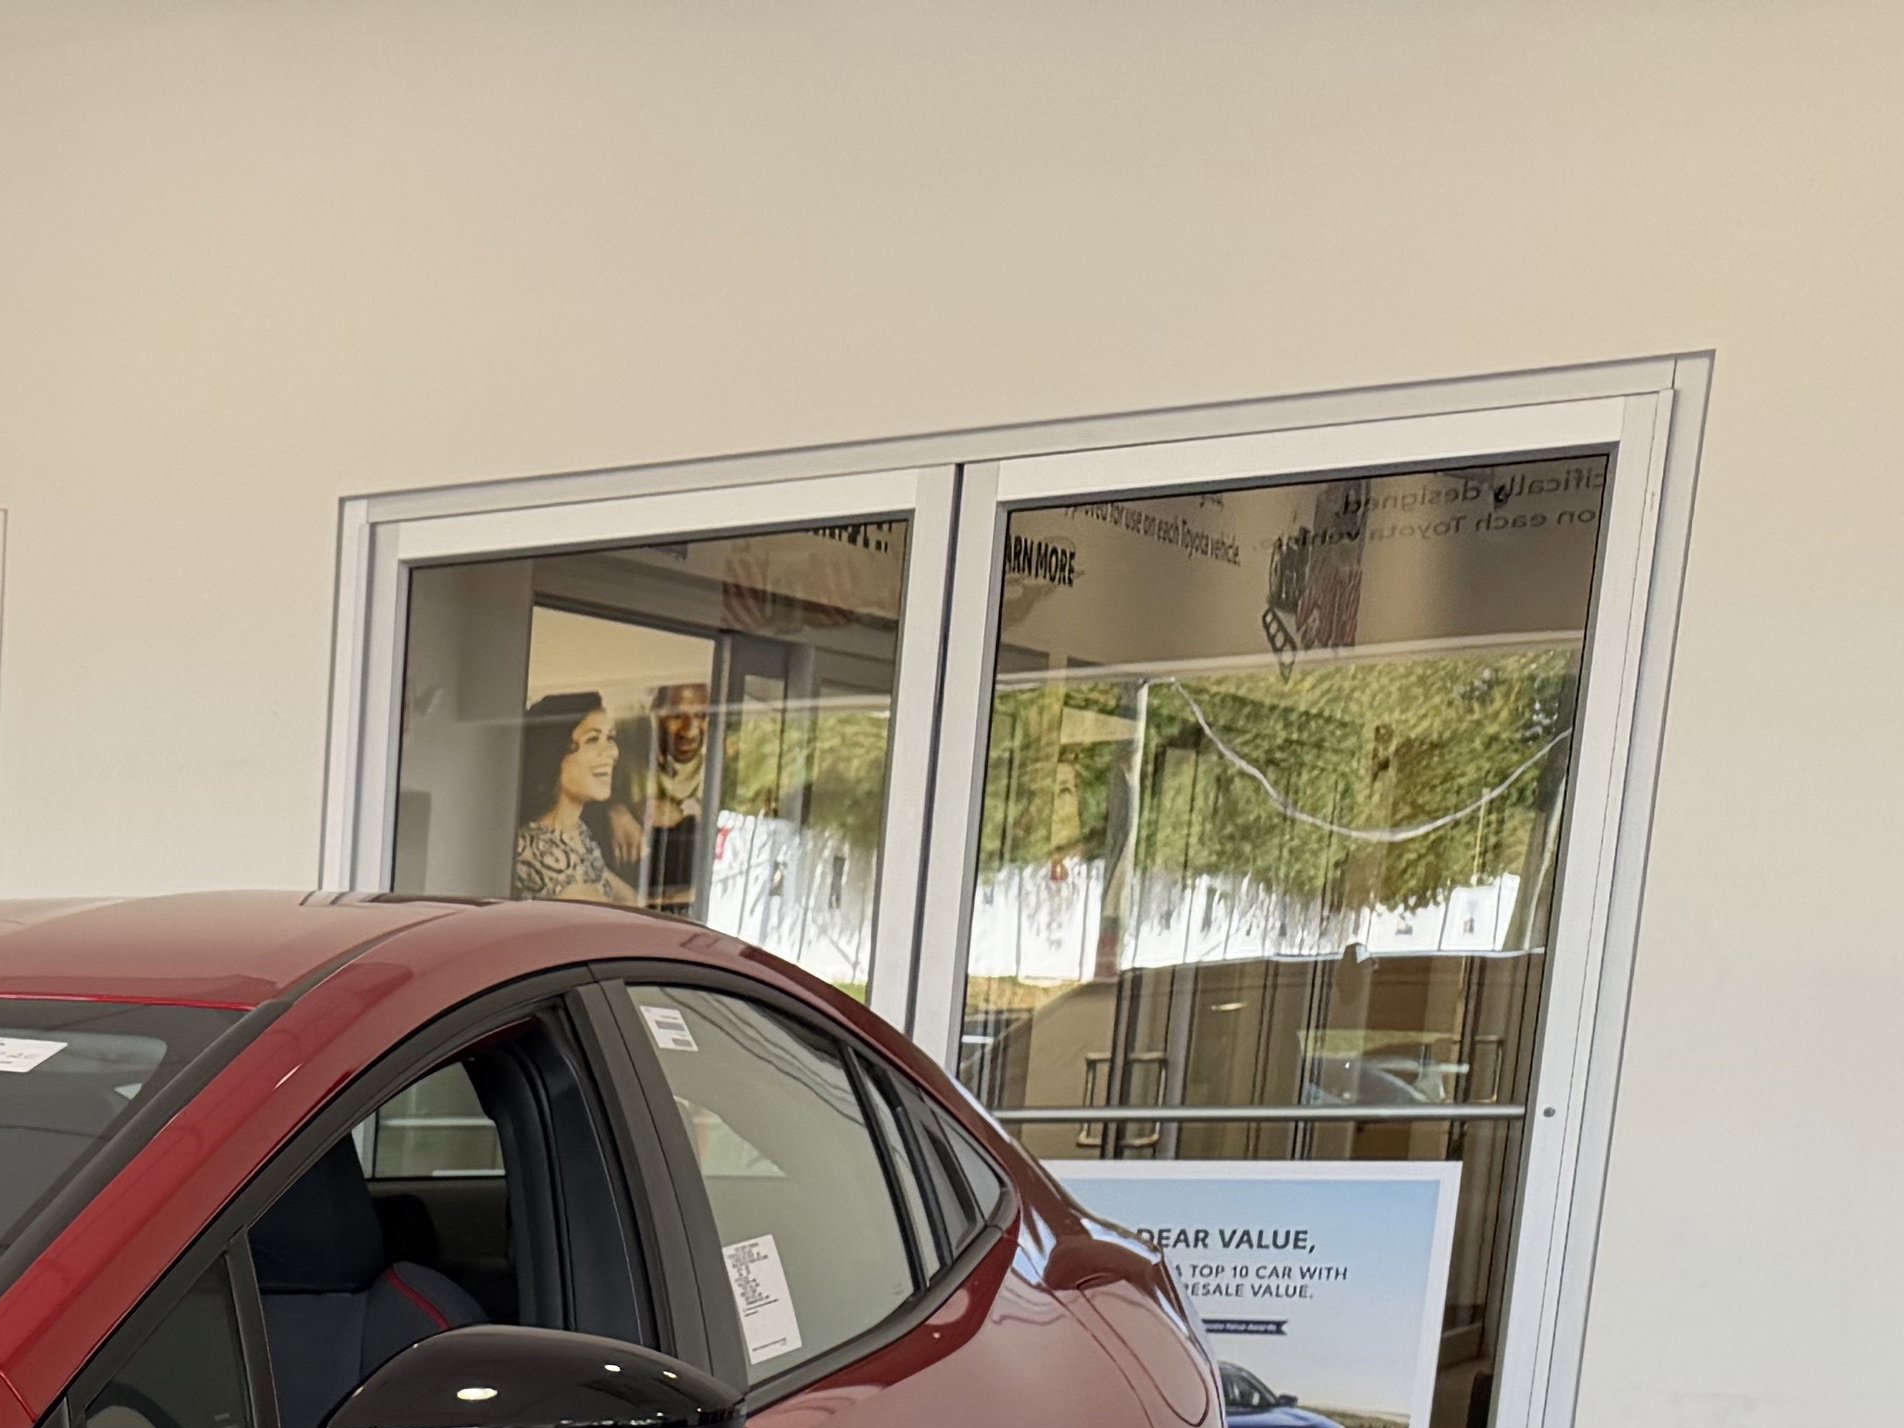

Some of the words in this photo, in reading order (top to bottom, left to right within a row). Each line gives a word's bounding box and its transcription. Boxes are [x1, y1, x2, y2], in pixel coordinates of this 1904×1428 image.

[1036, 542, 1076, 587] MORE
[1219, 1229, 1316, 1254] VALUE,
[1191, 1265, 1226, 1279] TOP
[1232, 1265, 1249, 1279] 10
[1255, 1265, 1292, 1280] CAR
[1299, 1266, 1348, 1281] WITH
